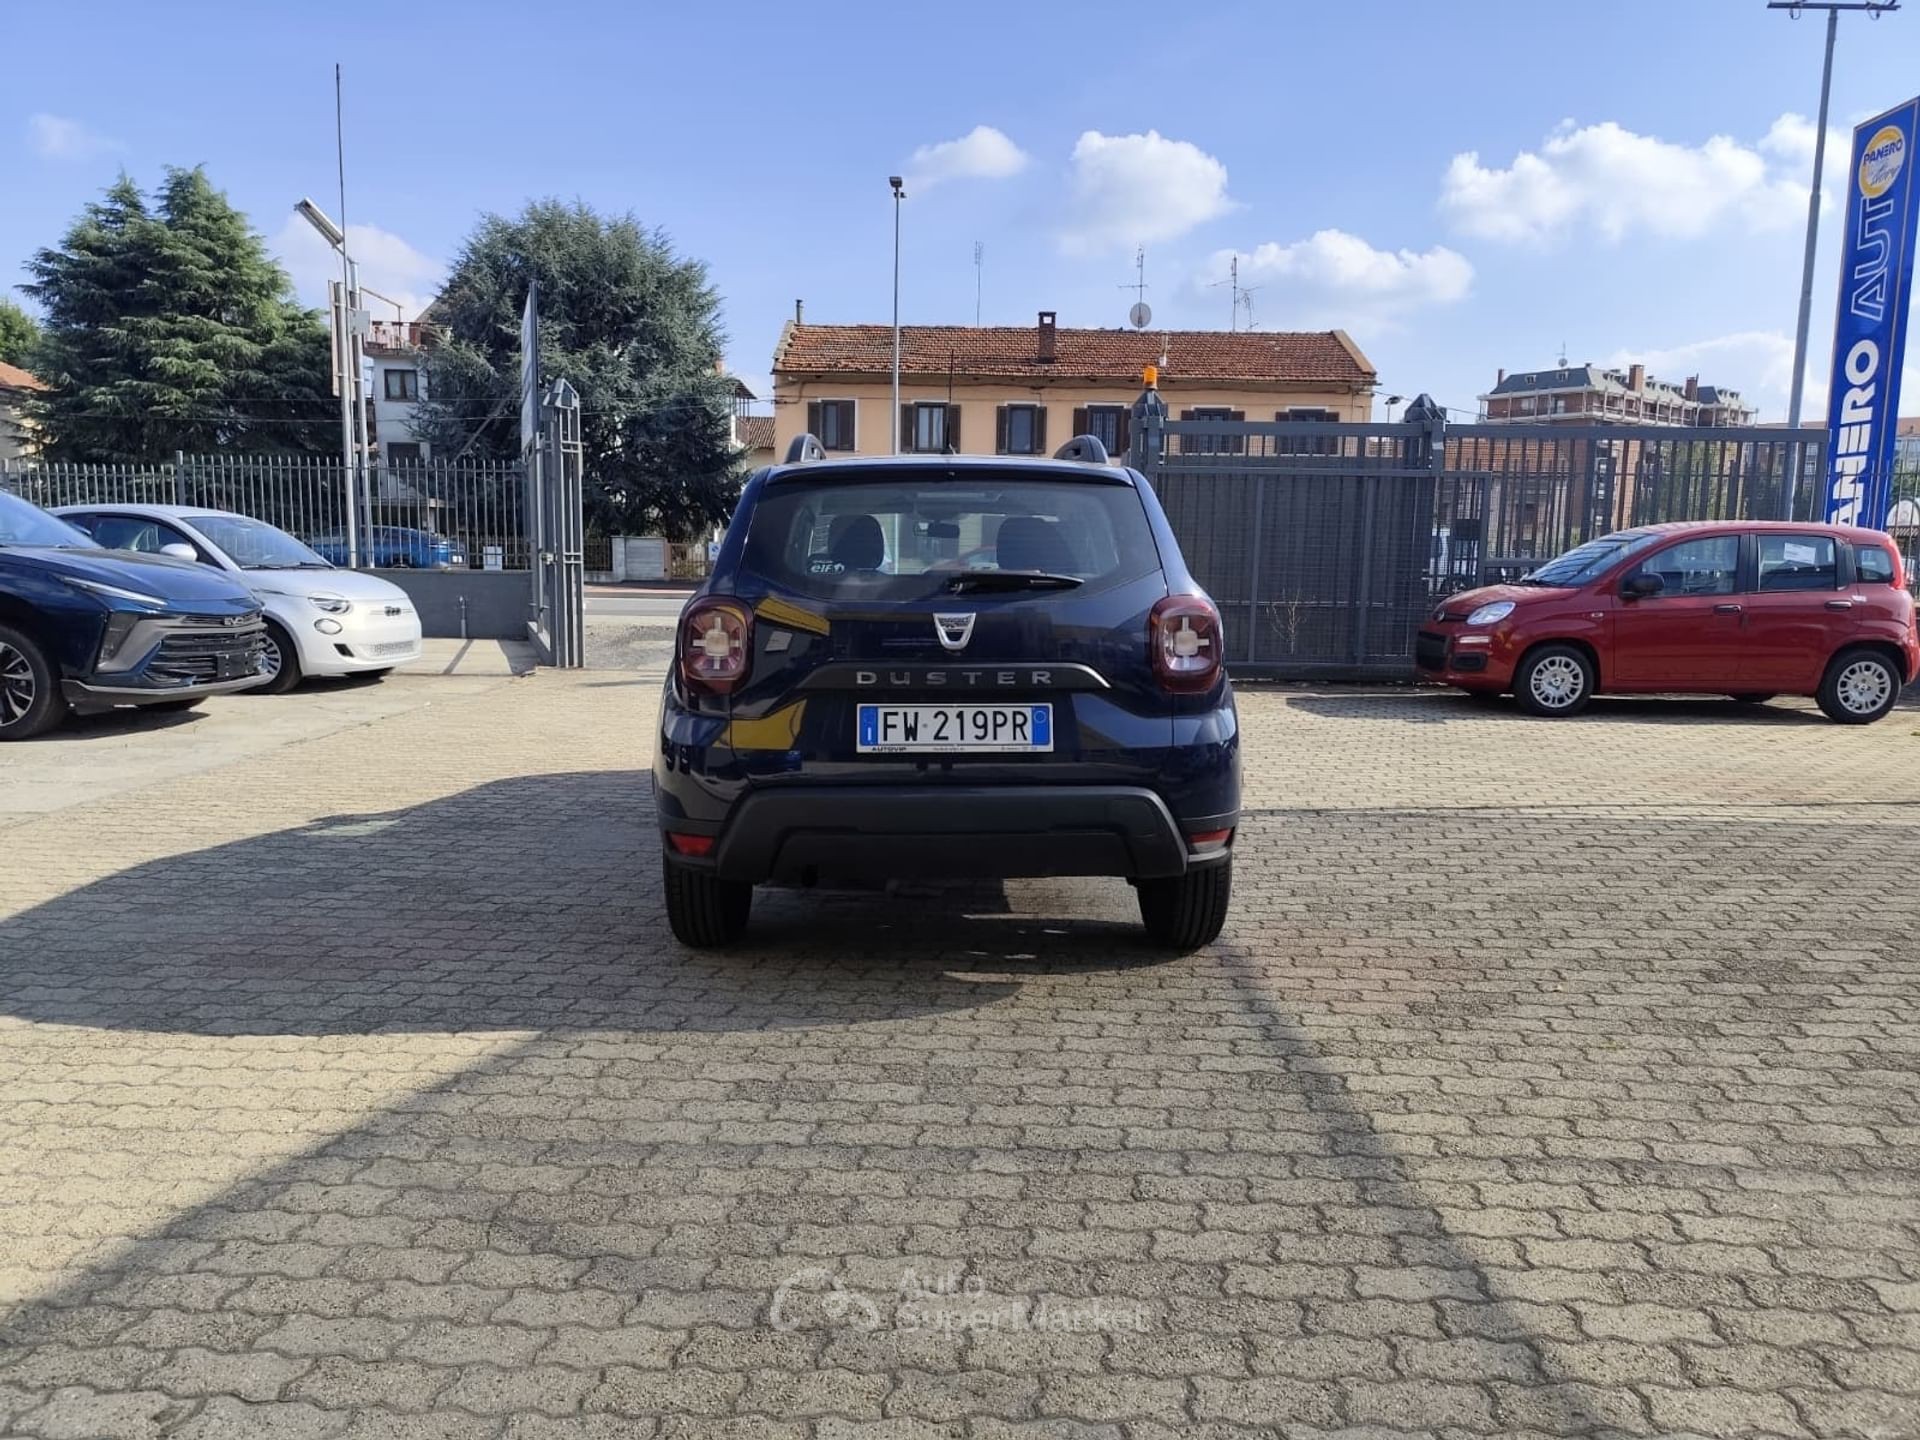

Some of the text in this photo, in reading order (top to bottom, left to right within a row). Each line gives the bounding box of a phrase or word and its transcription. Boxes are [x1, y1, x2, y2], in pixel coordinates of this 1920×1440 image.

[1863, 138, 1903, 165] PANERO
[1829, 339, 1879, 526] ANERO
[857, 671, 1051, 684] DUSTER
[882, 711, 1028, 741] FW 219PR
